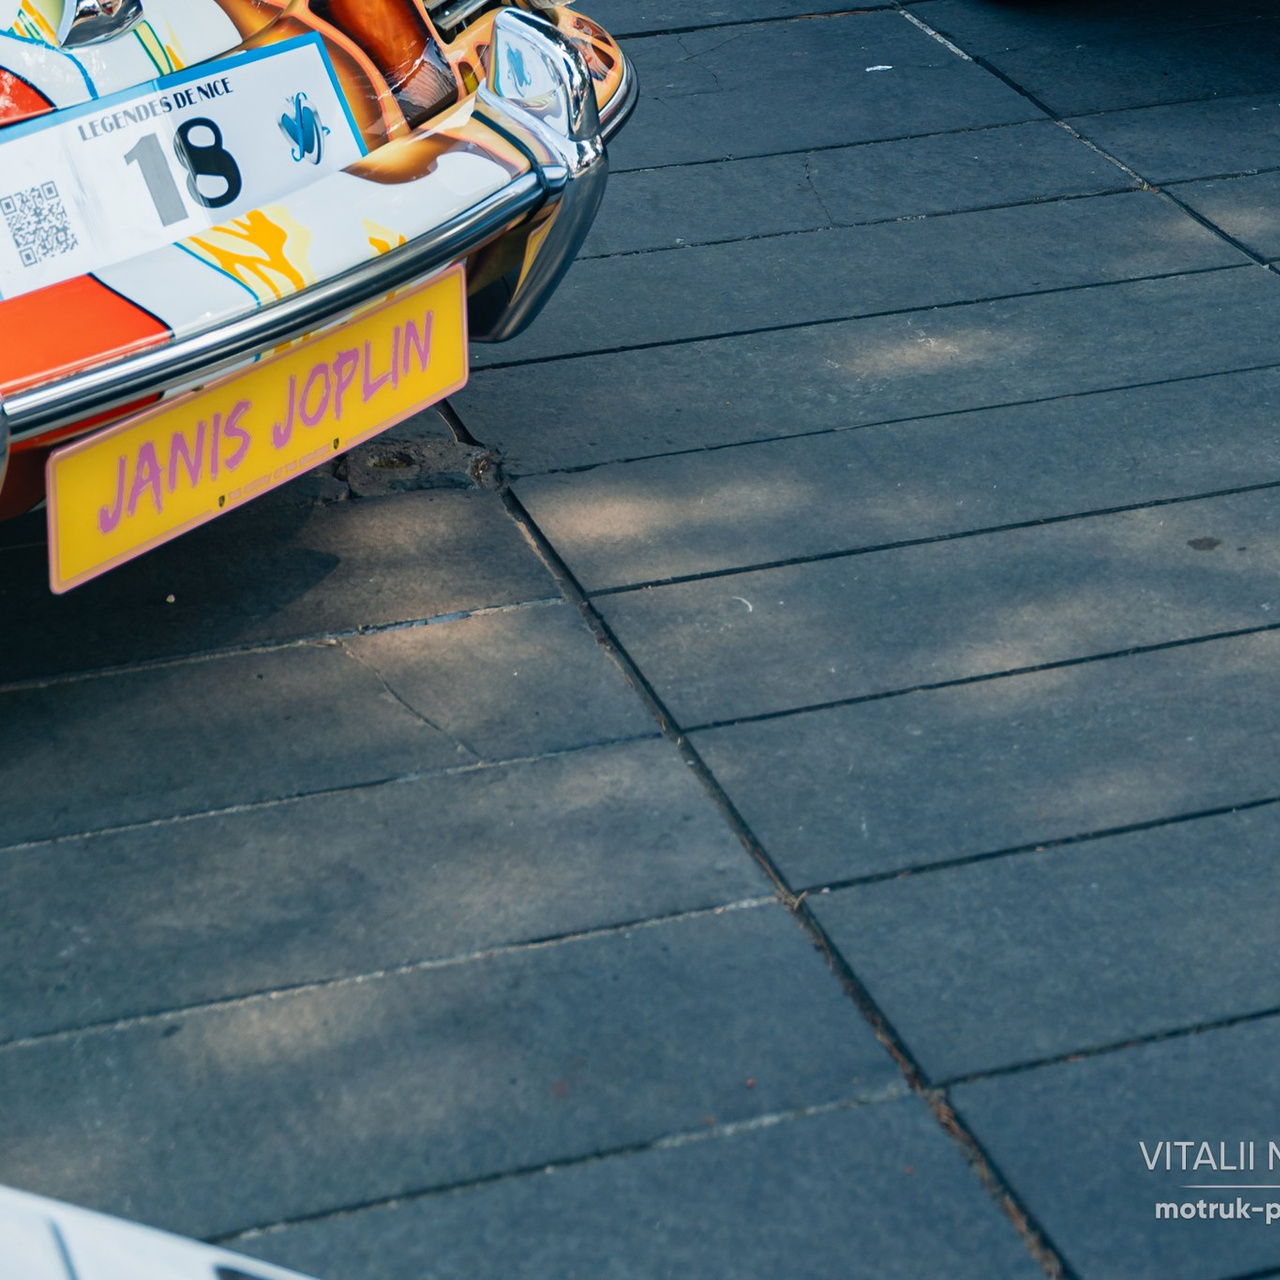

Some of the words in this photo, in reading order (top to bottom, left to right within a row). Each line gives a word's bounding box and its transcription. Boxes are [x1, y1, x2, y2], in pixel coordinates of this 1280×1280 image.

[77, 95, 173, 142] LEGENDES
[173, 88, 198, 110] DE
[196, 77, 234, 101] NICE
[123, 117, 242, 227] 18
[97, 399, 252, 534] JANIS
[271, 309, 434, 449] JOPLIN
